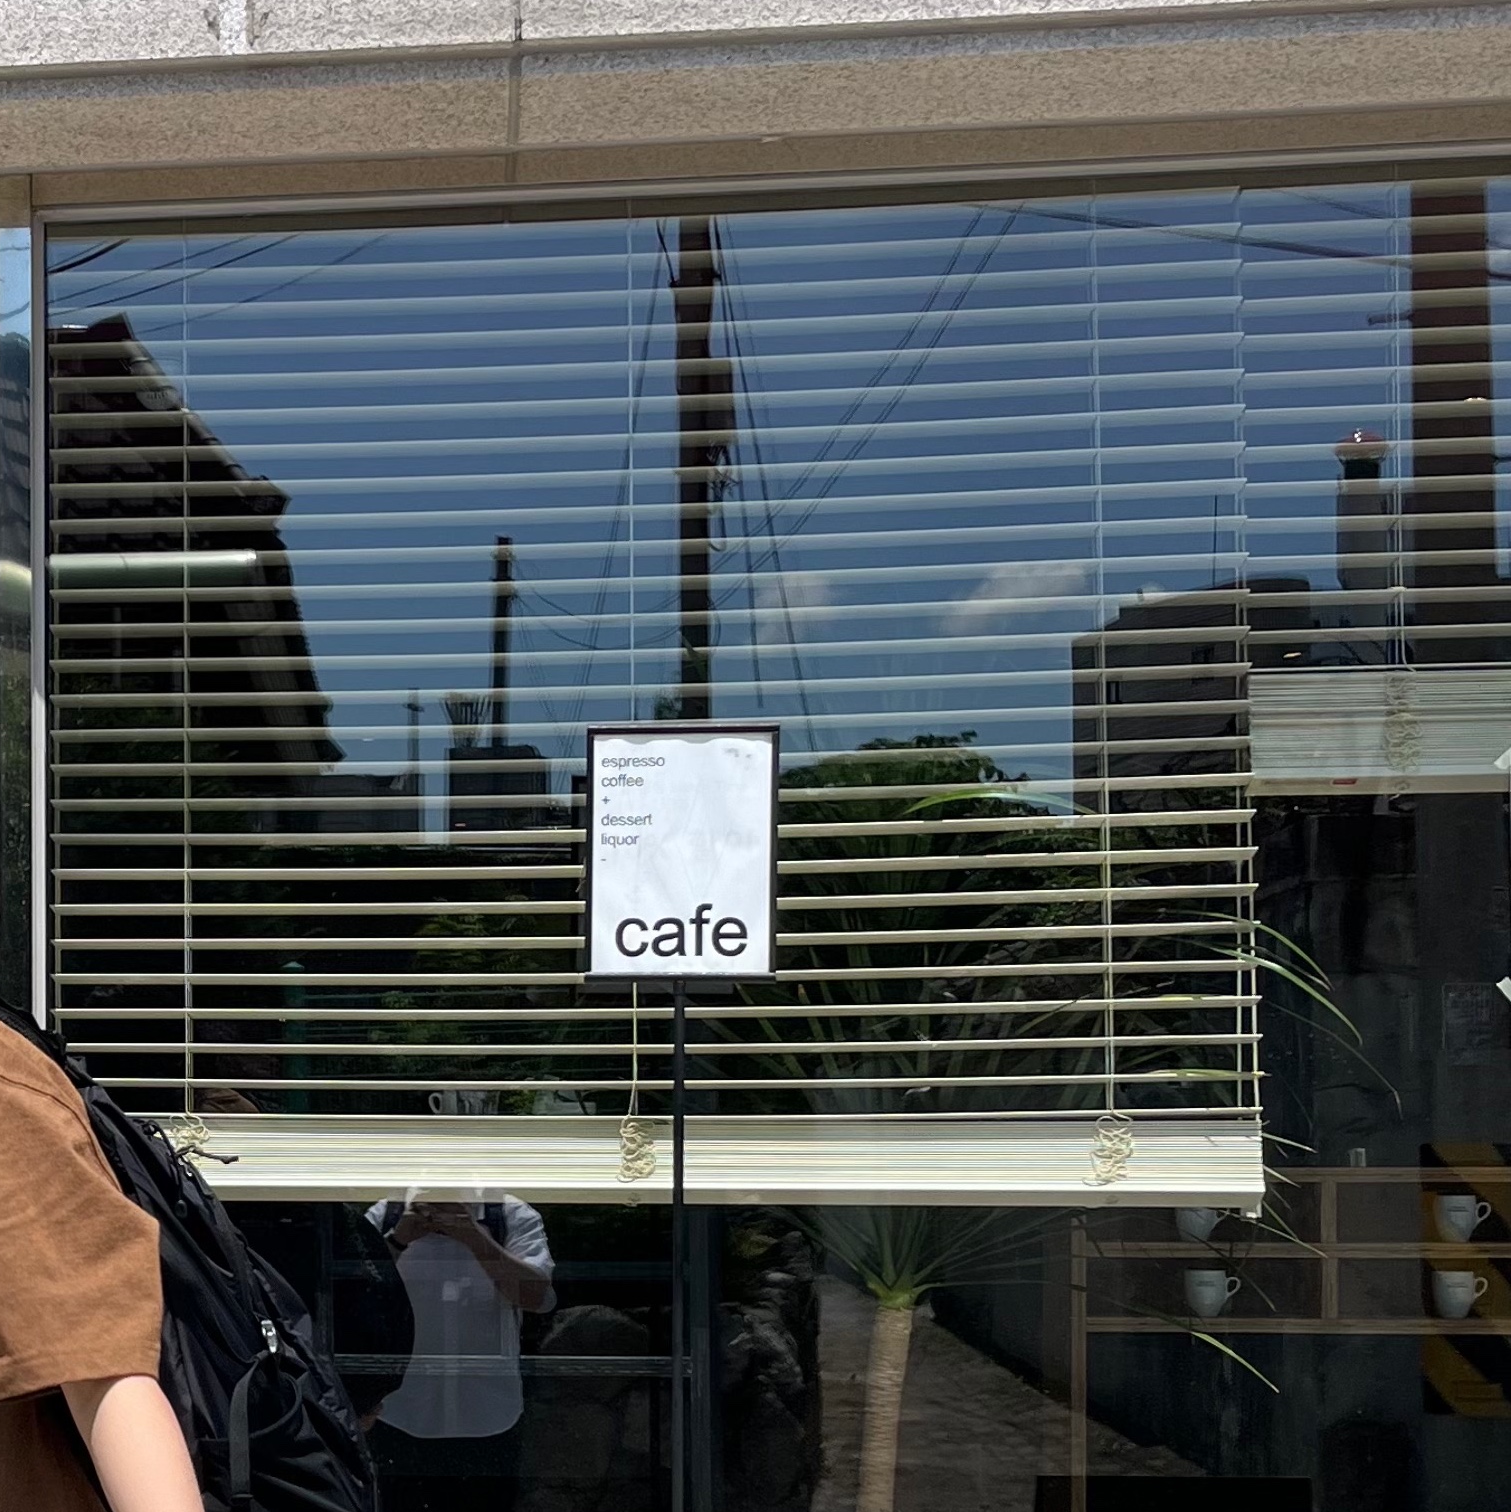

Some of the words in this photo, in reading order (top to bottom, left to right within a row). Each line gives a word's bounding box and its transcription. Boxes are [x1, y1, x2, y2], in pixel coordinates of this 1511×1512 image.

[601, 756, 665, 769] espresso
[601, 773, 644, 788] coffee
[601, 813, 653, 827] dessert
[601, 832, 641, 849] liquor
[614, 902, 748, 957] cafe
